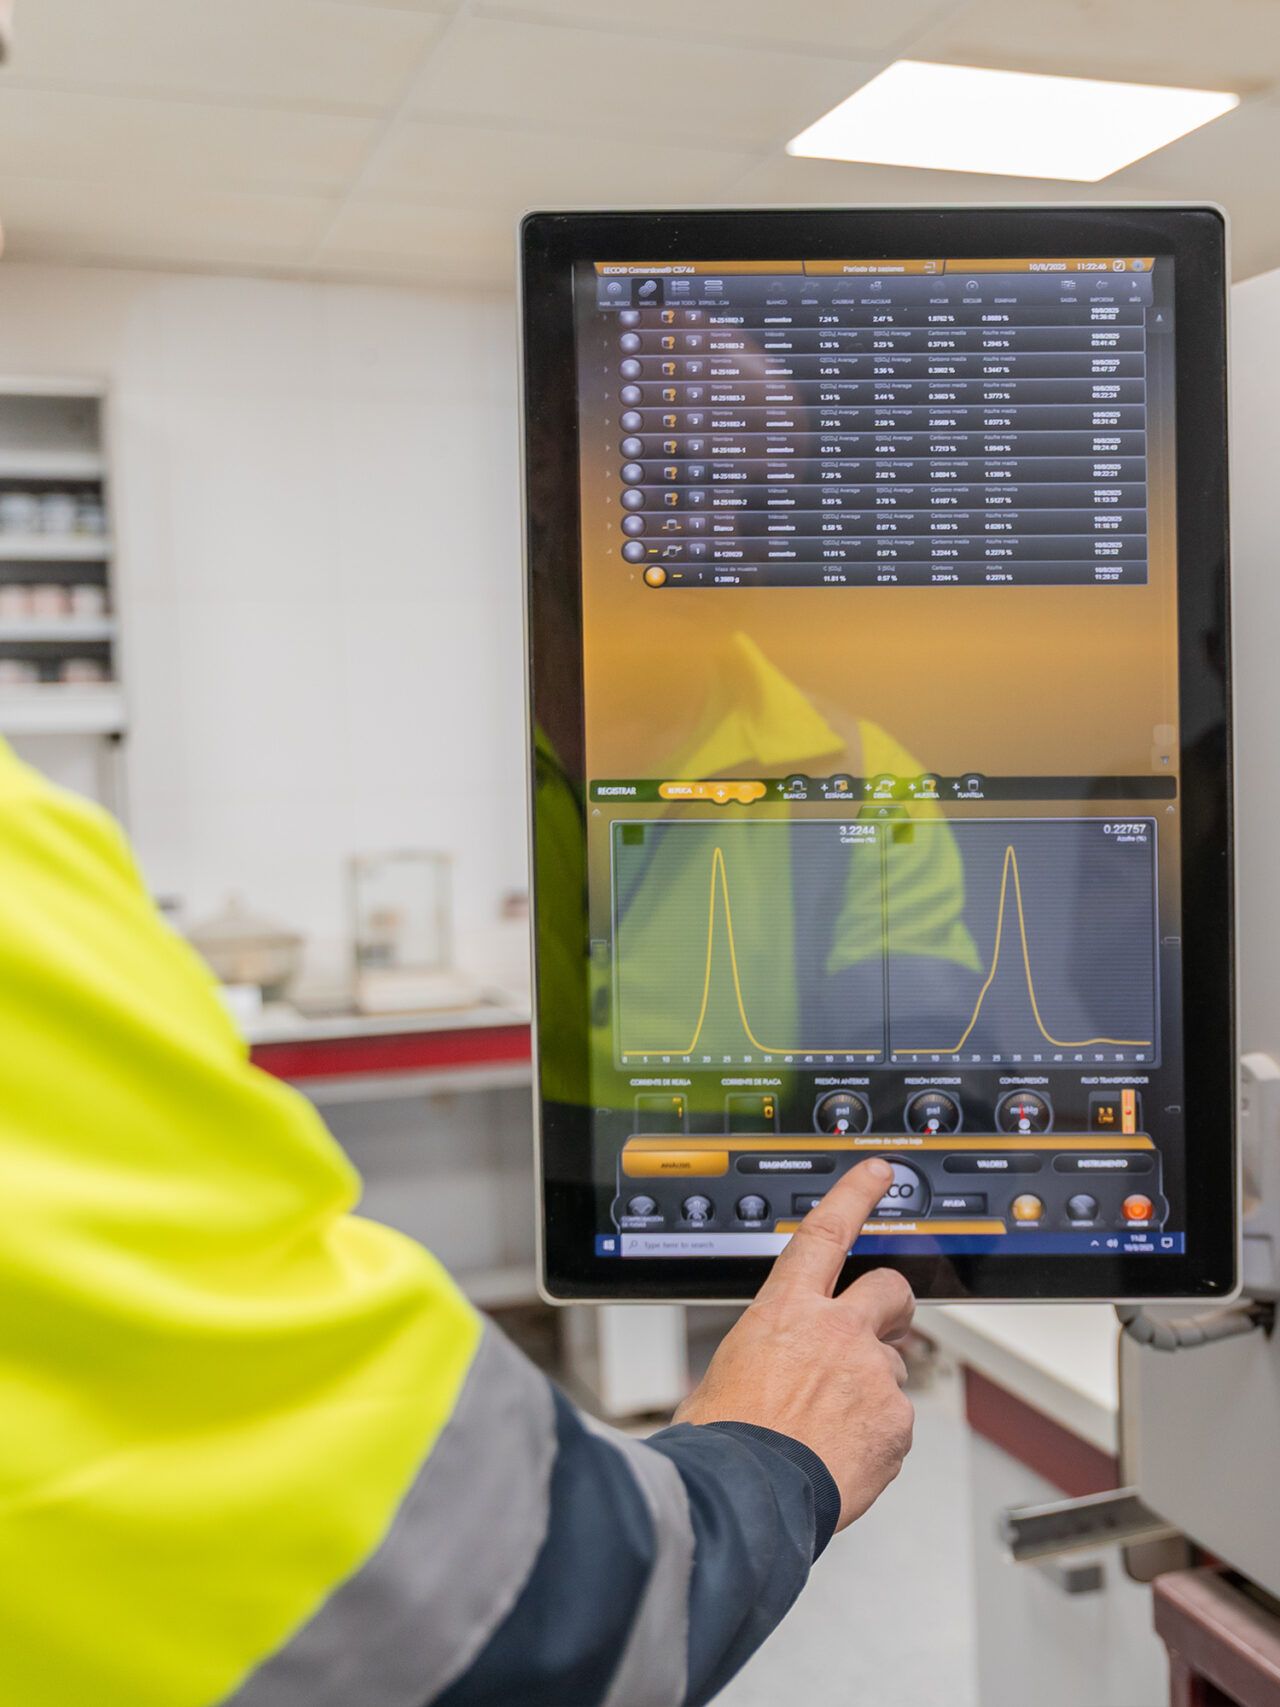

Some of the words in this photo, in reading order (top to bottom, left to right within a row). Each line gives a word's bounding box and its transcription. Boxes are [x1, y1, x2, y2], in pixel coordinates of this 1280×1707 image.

[840, 826, 875, 835] 3.2244
[1103, 824, 1146, 834] 0.22757
[836, 1106, 850, 1116] psi
[926, 1106, 940, 1116] psi
[759, 1160, 812, 1170] DIAGNÓSTICOS
[977, 1160, 1008, 1168] VALORES
[1078, 1159, 1128, 1168] INSTRUMENTO
[943, 1199, 966, 1208] AYUDA
